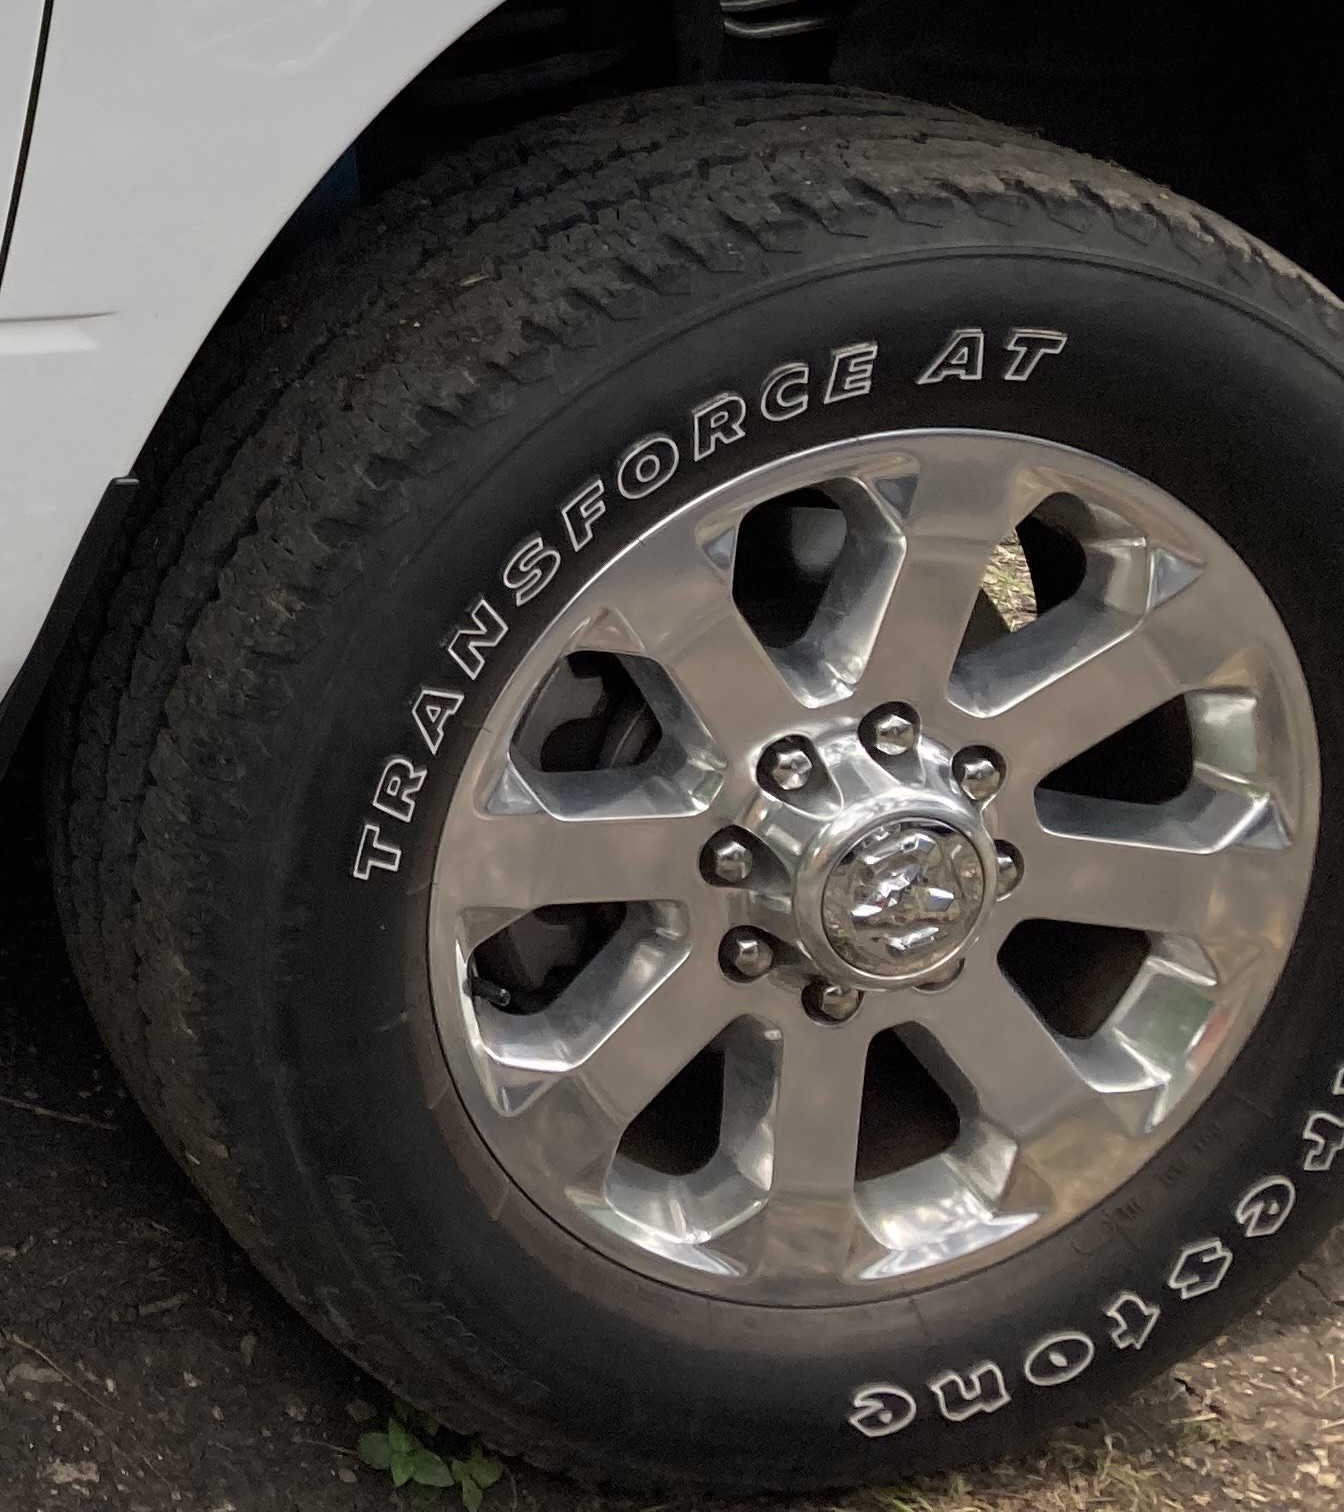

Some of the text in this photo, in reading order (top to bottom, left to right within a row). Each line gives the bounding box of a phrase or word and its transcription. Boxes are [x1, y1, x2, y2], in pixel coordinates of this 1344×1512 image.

[353, 328, 1067, 883] TRANSFORCE AT
[848, 1066, 1344, 1438] restone
